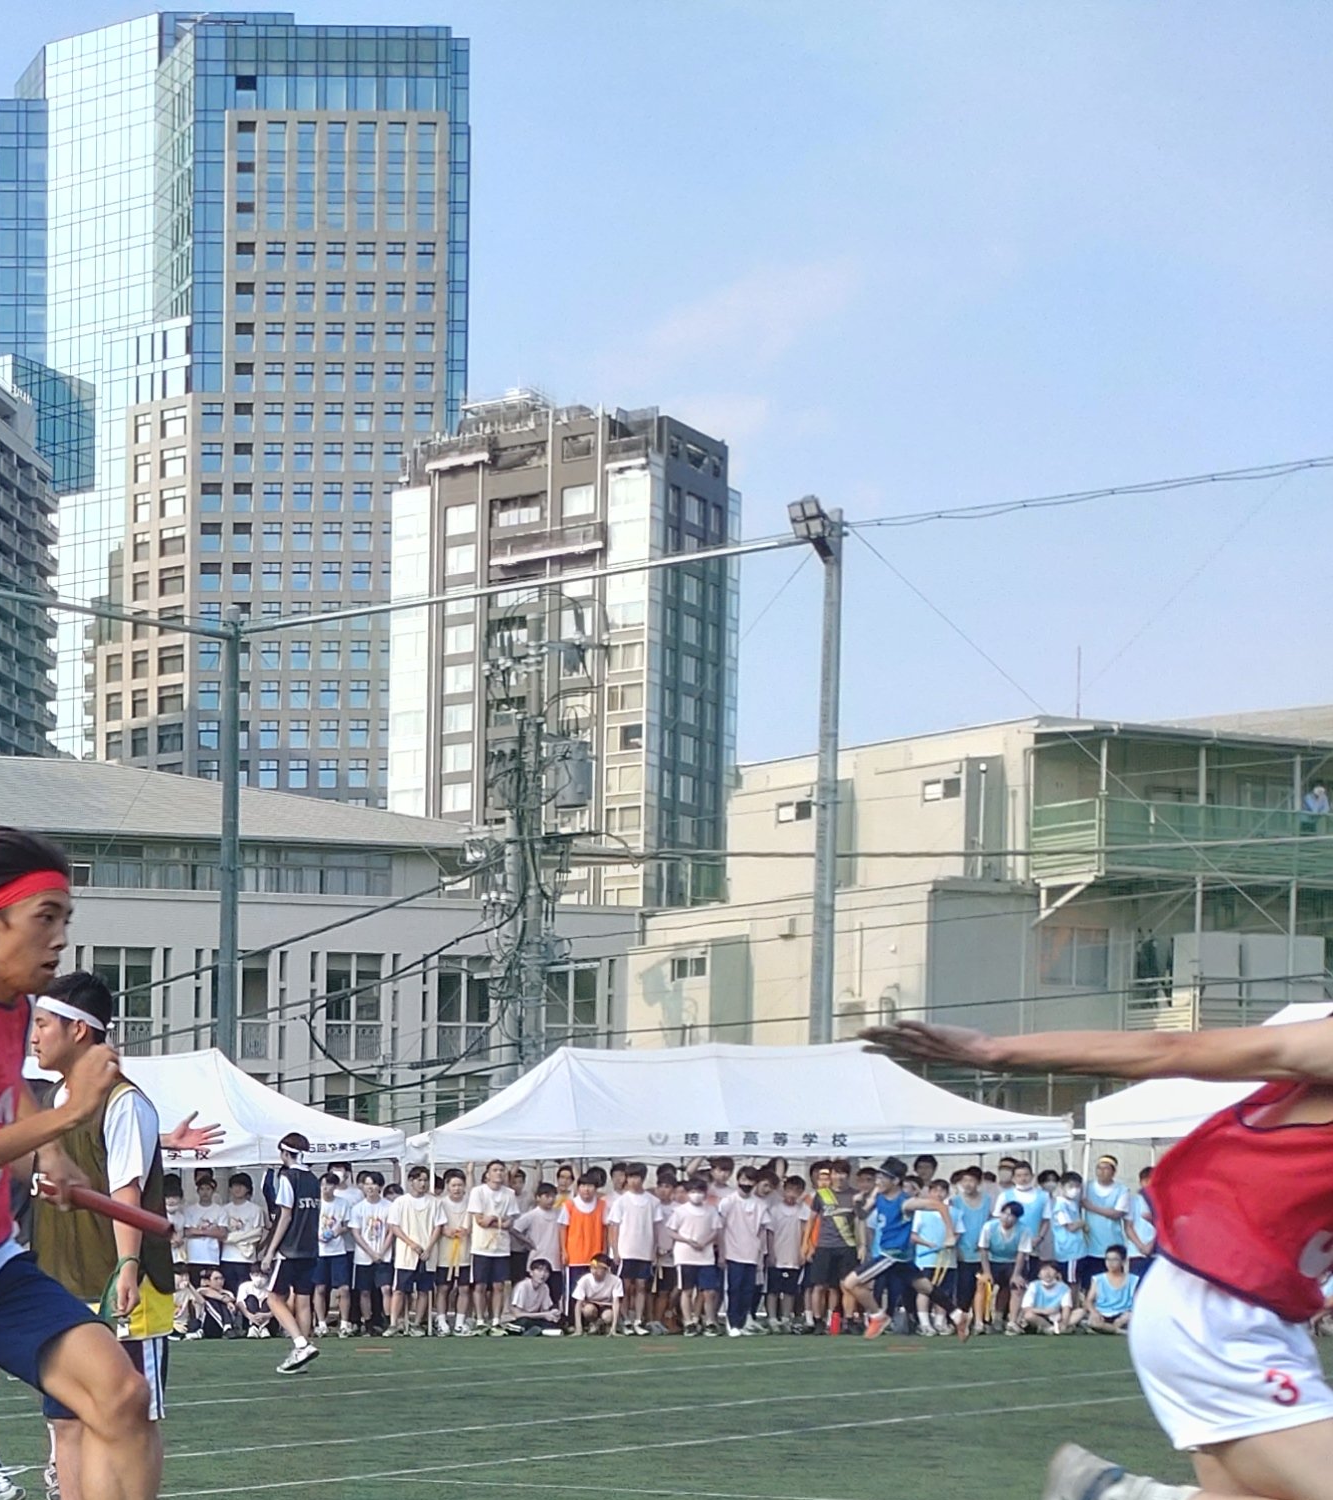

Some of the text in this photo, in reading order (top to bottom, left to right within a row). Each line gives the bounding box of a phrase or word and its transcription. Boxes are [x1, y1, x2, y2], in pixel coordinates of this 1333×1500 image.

[684, 1131, 848, 1148] 暁星高等学校
[1266, 1368, 1300, 1406] 3
